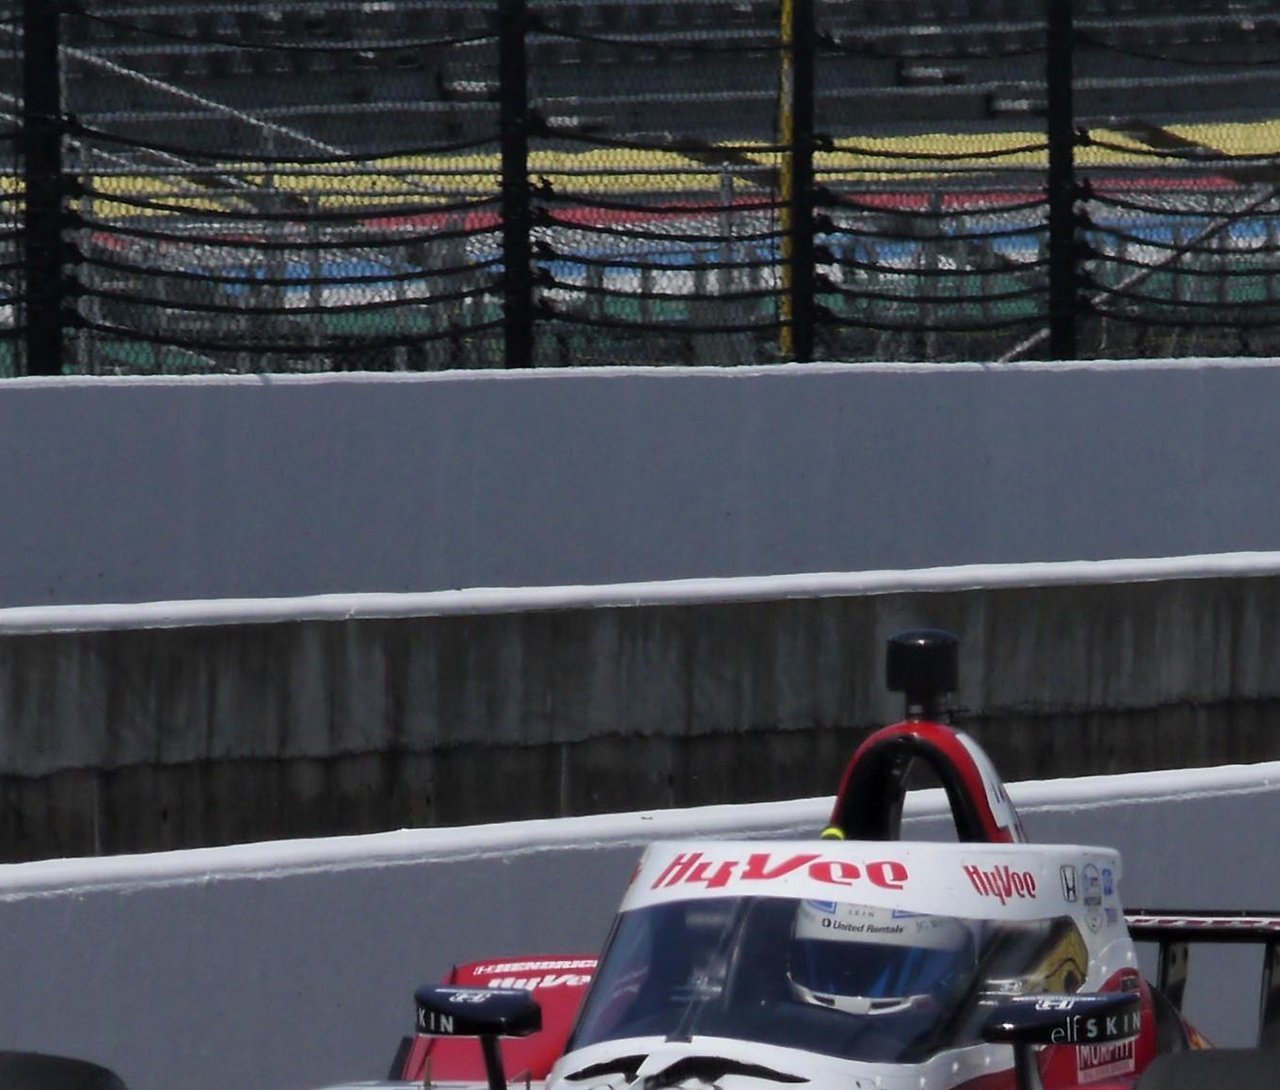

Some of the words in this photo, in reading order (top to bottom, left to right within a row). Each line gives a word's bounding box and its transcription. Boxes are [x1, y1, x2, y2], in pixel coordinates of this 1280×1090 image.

[833, 920, 864, 933] United
[866, 924, 904, 934] Rentals
[494, 960, 599, 975] HENDRIC
[1051, 1015, 1081, 1044] elf
[1086, 1011, 1141, 1038] SKIN
